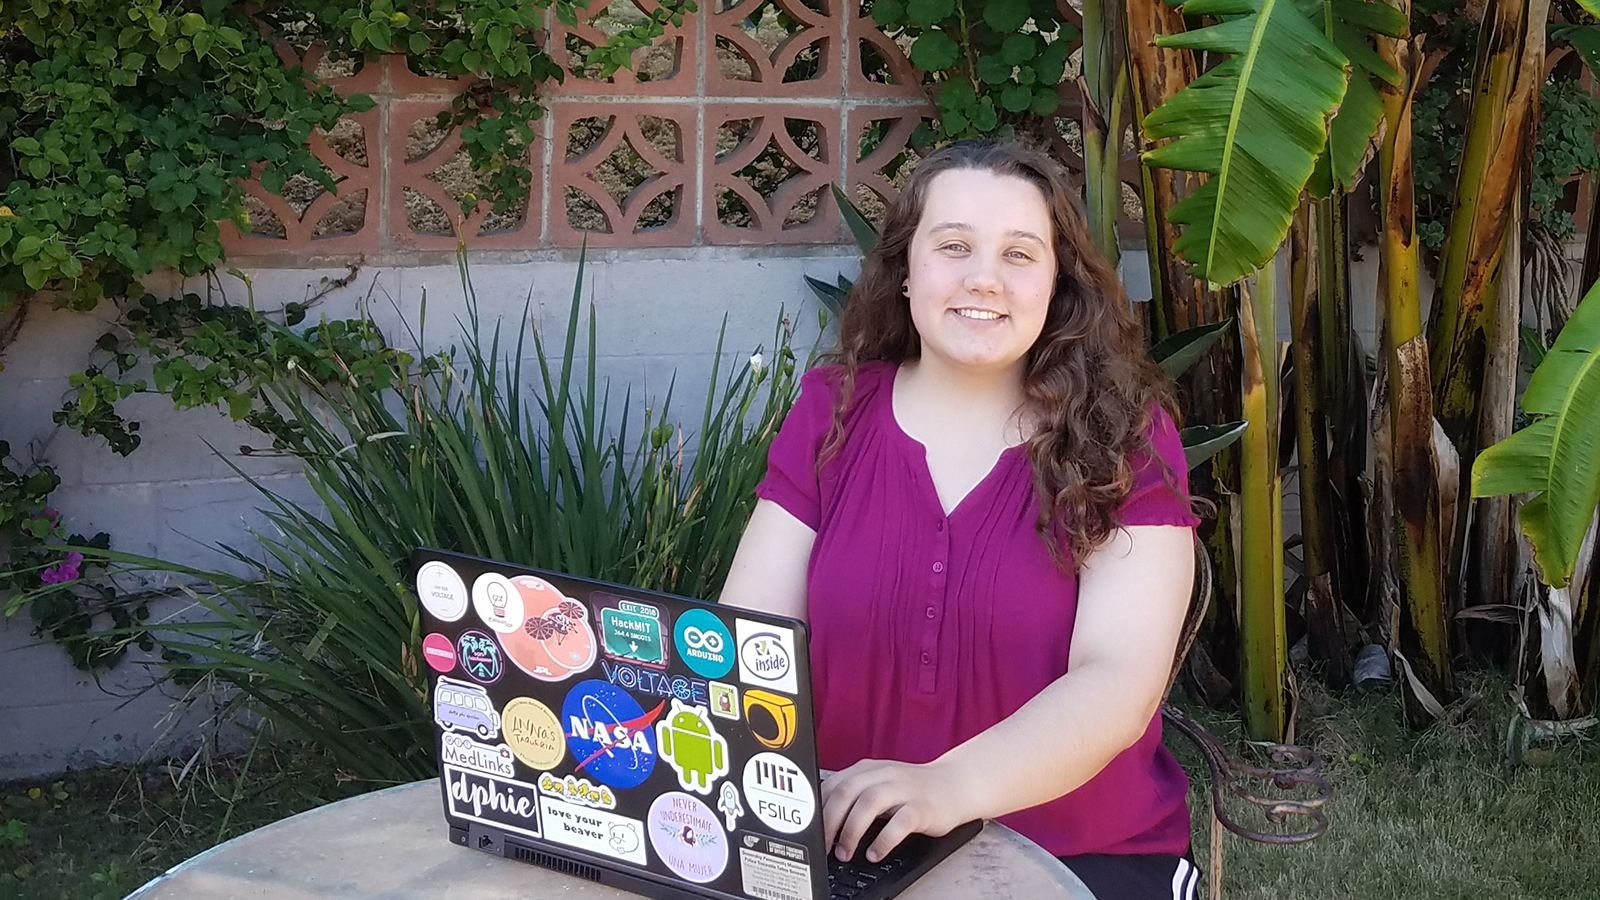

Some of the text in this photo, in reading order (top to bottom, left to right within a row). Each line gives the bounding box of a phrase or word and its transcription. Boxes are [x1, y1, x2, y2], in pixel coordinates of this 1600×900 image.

[622, 604, 656, 616] EXIT 2018
[611, 616, 651, 634] HackMIT
[614, 629, 630, 638] 364.4
[686, 648, 724, 664] ARDUINO
[756, 654, 785, 671] inside
[534, 666, 552, 676] JPL
[602, 662, 708, 706] VOLTAGE
[570, 716, 652, 754] NASA
[446, 745, 511, 774] MedLinks
[756, 760, 798, 793] MIT
[452, 772, 536, 817] dphie
[672, 798, 697, 812] NEVER
[548, 806, 602, 828] love your
[660, 810, 712, 833] UNDERESTIMATE
[758, 800, 802, 825] FSILG
[564, 822, 604, 840] beaver
[668, 855, 713, 876] UNA MUJER
